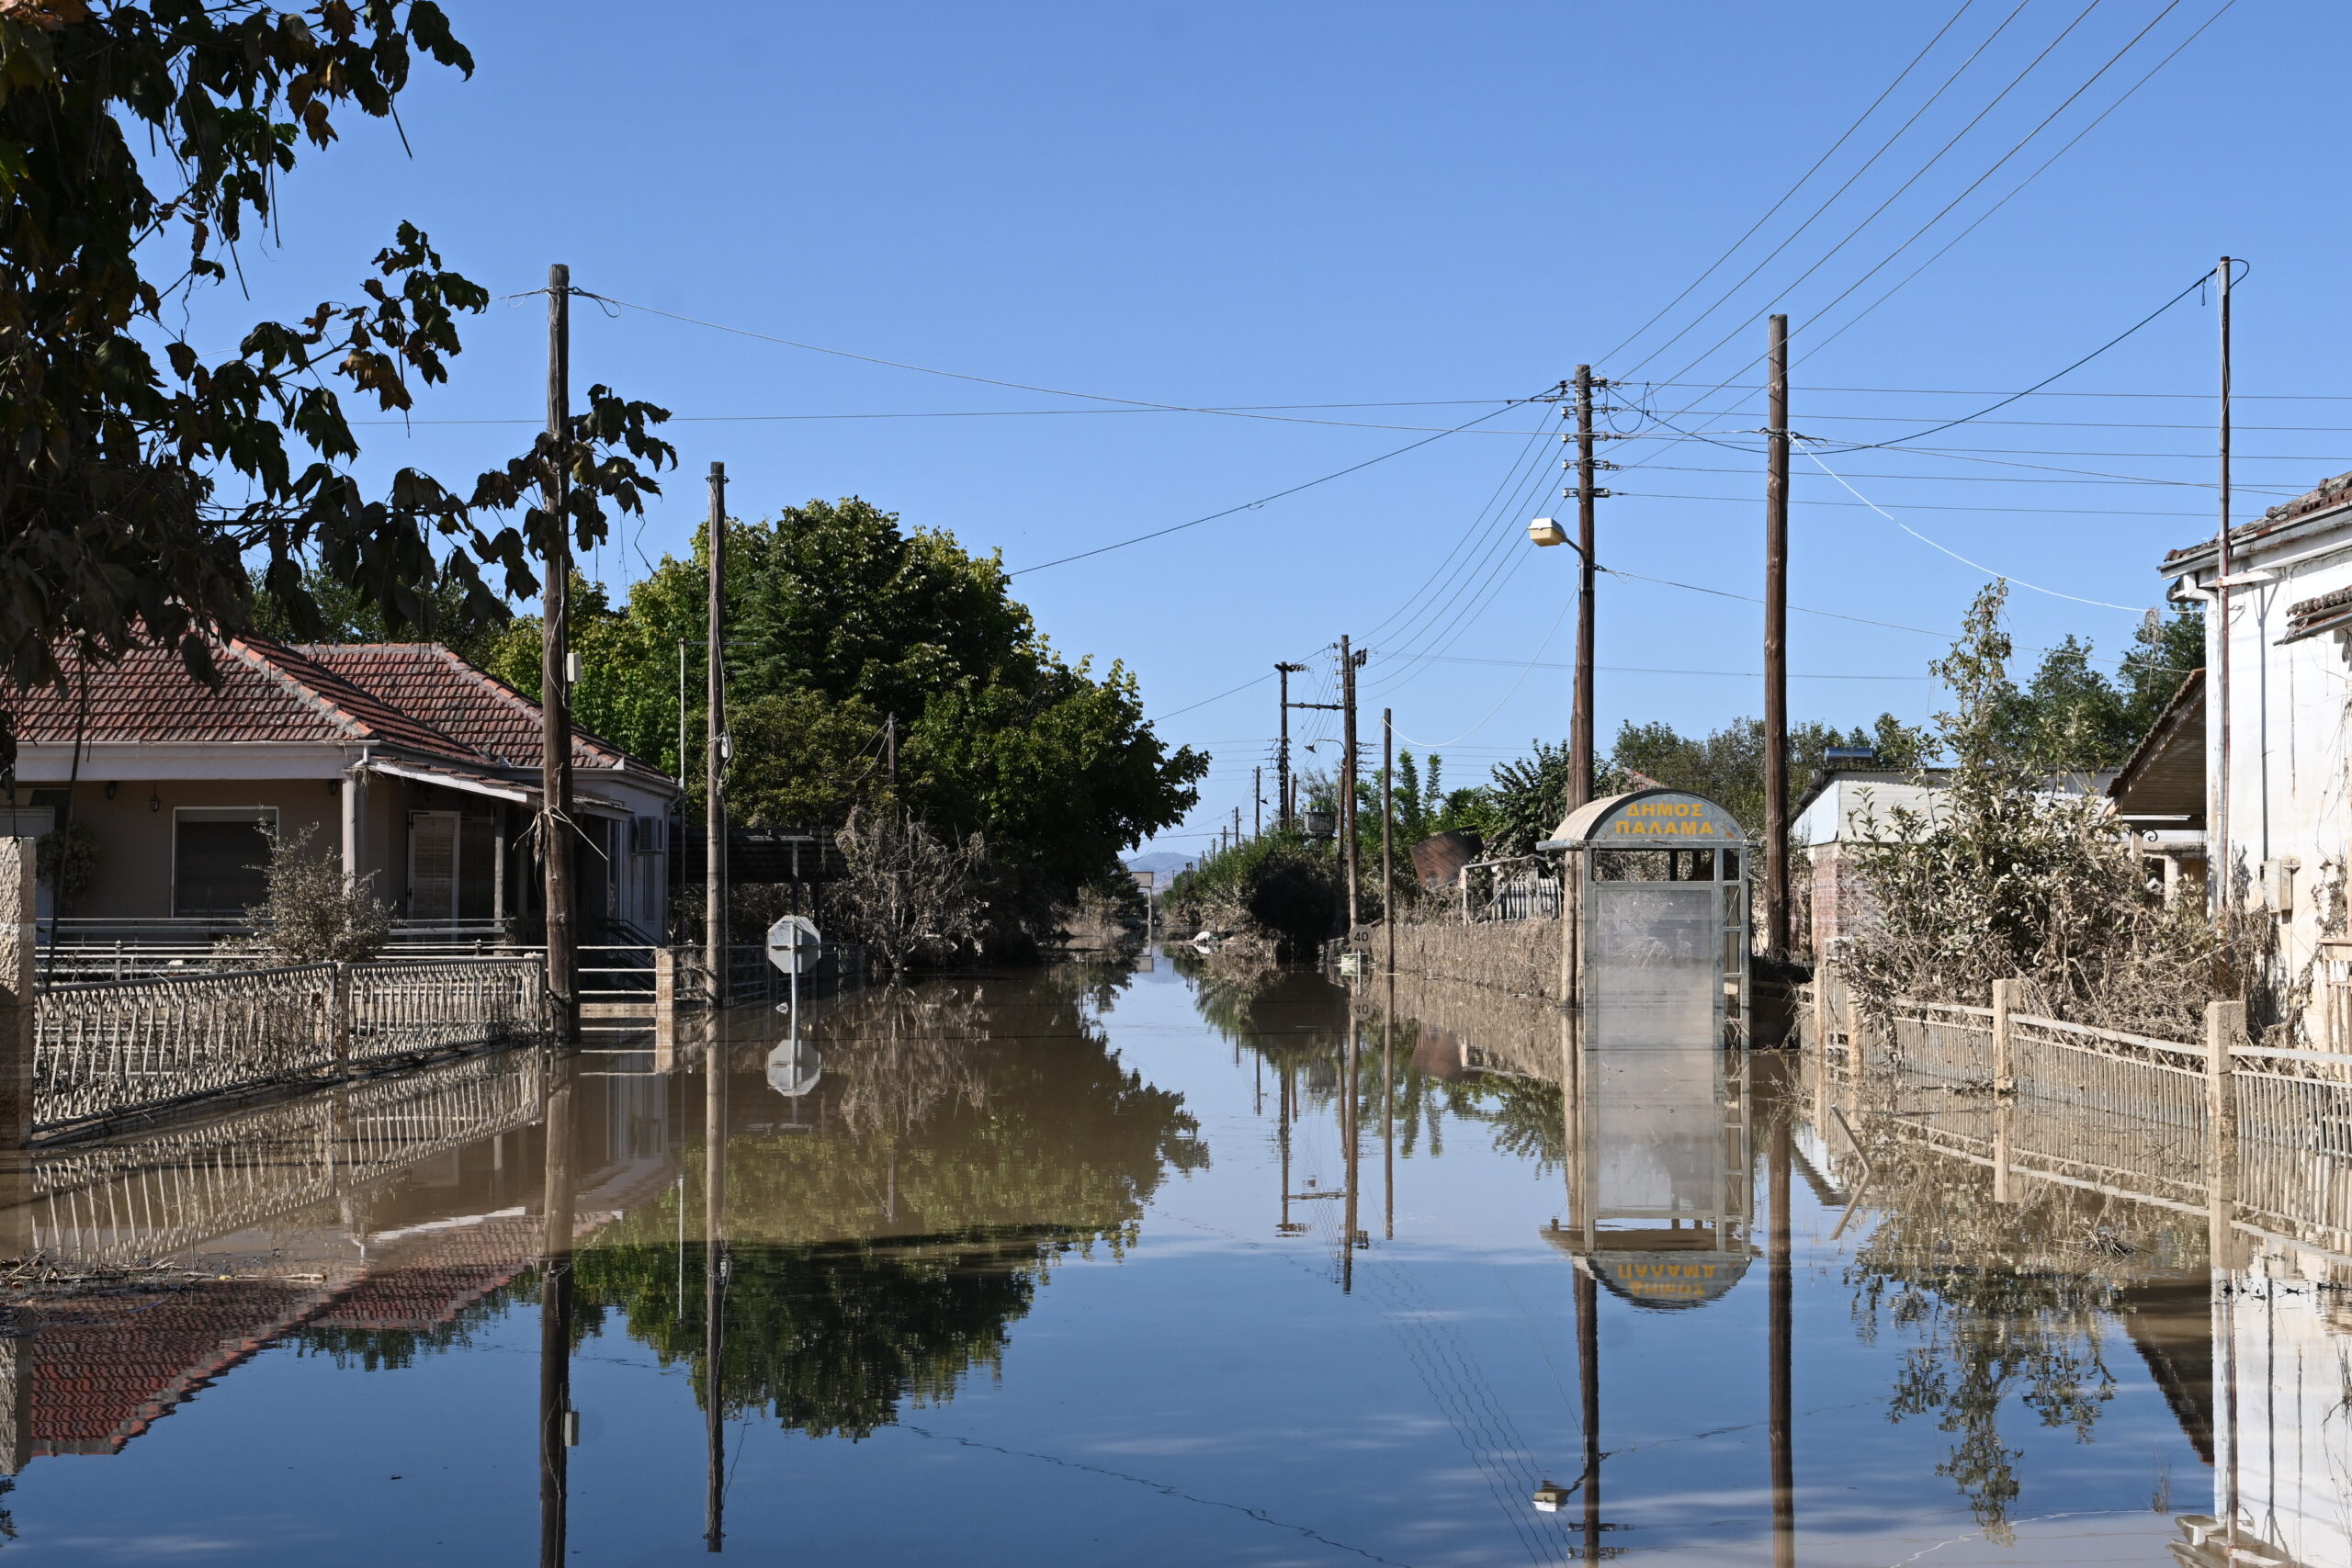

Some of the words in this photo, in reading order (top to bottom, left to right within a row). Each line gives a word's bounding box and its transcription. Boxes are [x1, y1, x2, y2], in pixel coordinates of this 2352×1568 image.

[1626, 803, 1704, 817] ΔΗΜΟΣ
[1615, 820, 1714, 835] ΠΑΛΑΜΑ
[1353, 931, 1369, 942] 40
